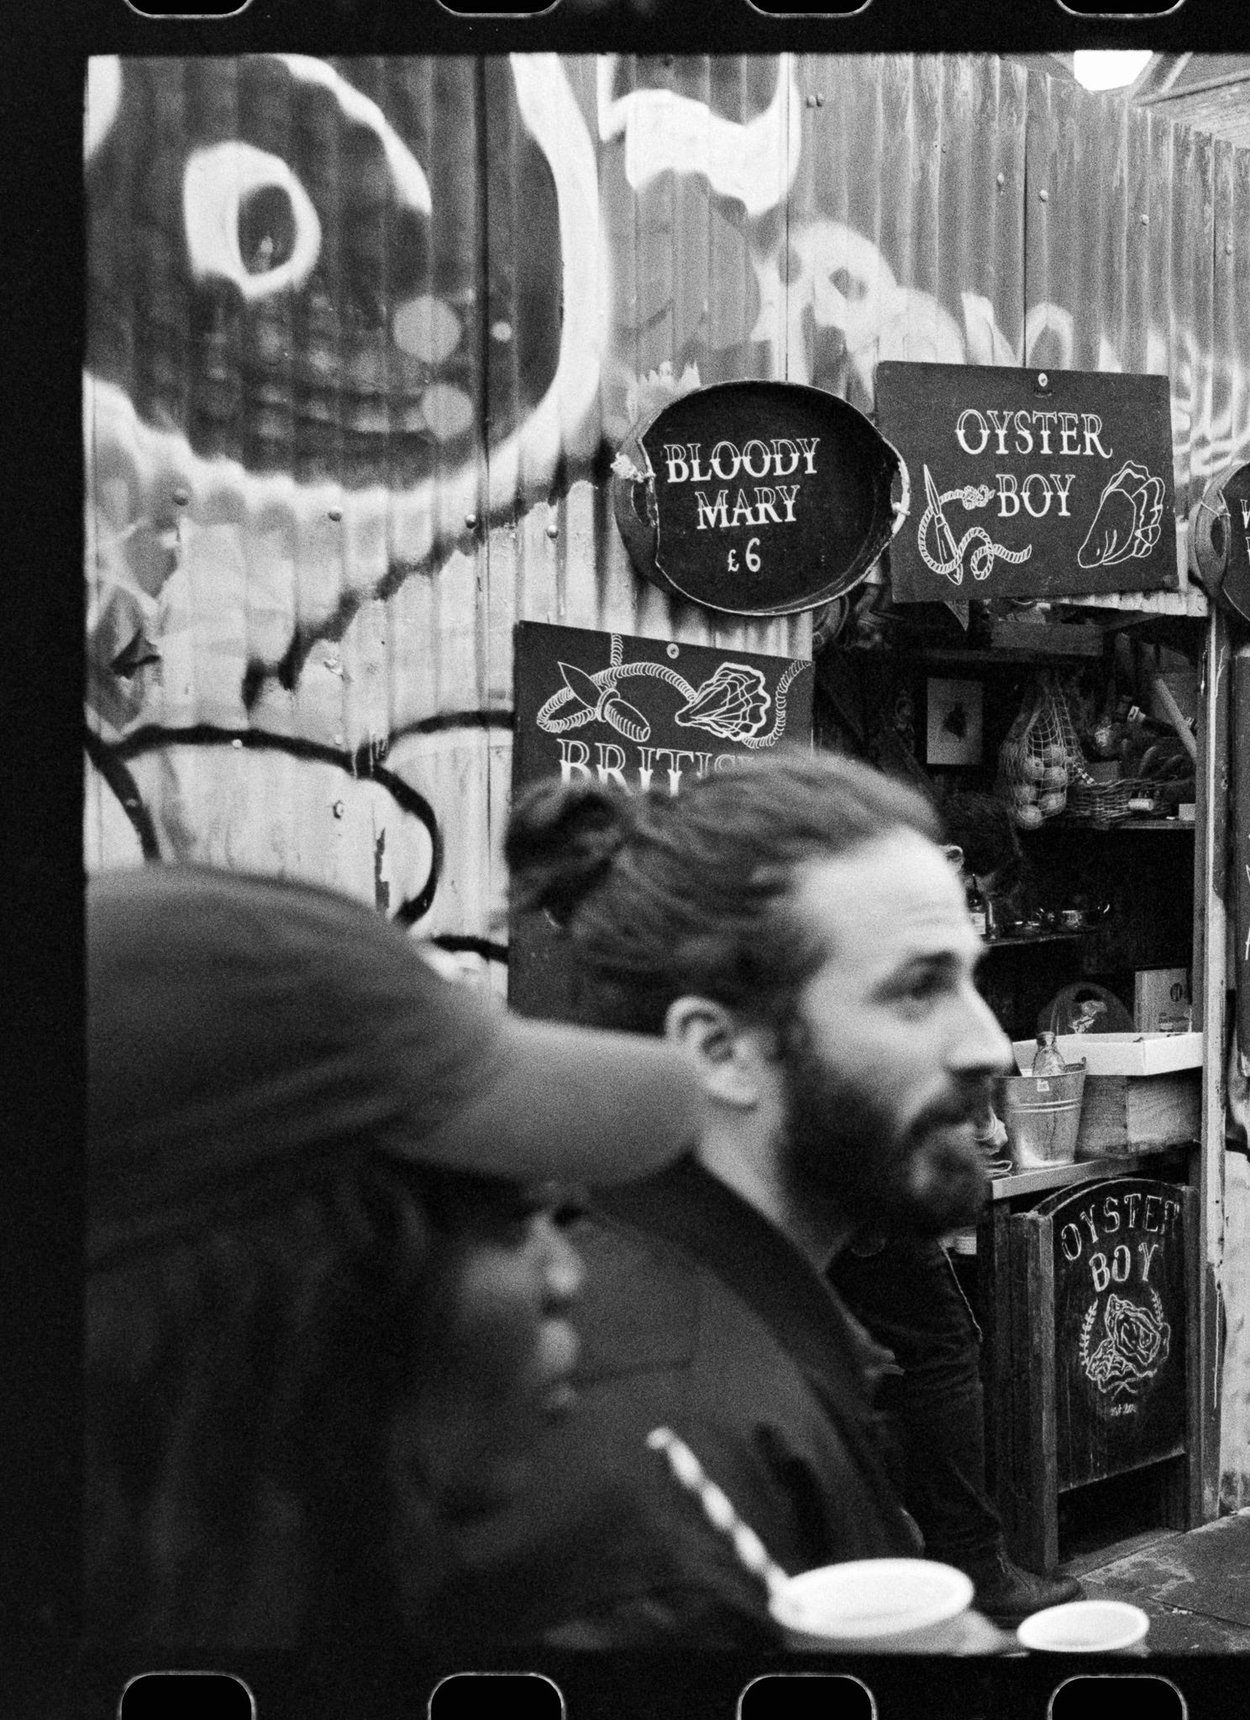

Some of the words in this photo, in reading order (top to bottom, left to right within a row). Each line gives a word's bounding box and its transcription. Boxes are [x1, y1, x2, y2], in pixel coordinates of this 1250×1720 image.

[955, 409, 1113, 459] OYSTER
[663, 437, 821, 483] BLOODY
[694, 484, 801, 530] MARY
[995, 473, 1076, 518] BOY
[1061, 1193, 1180, 1261] OYSTER
[1089, 1242, 1159, 1293] BOY
